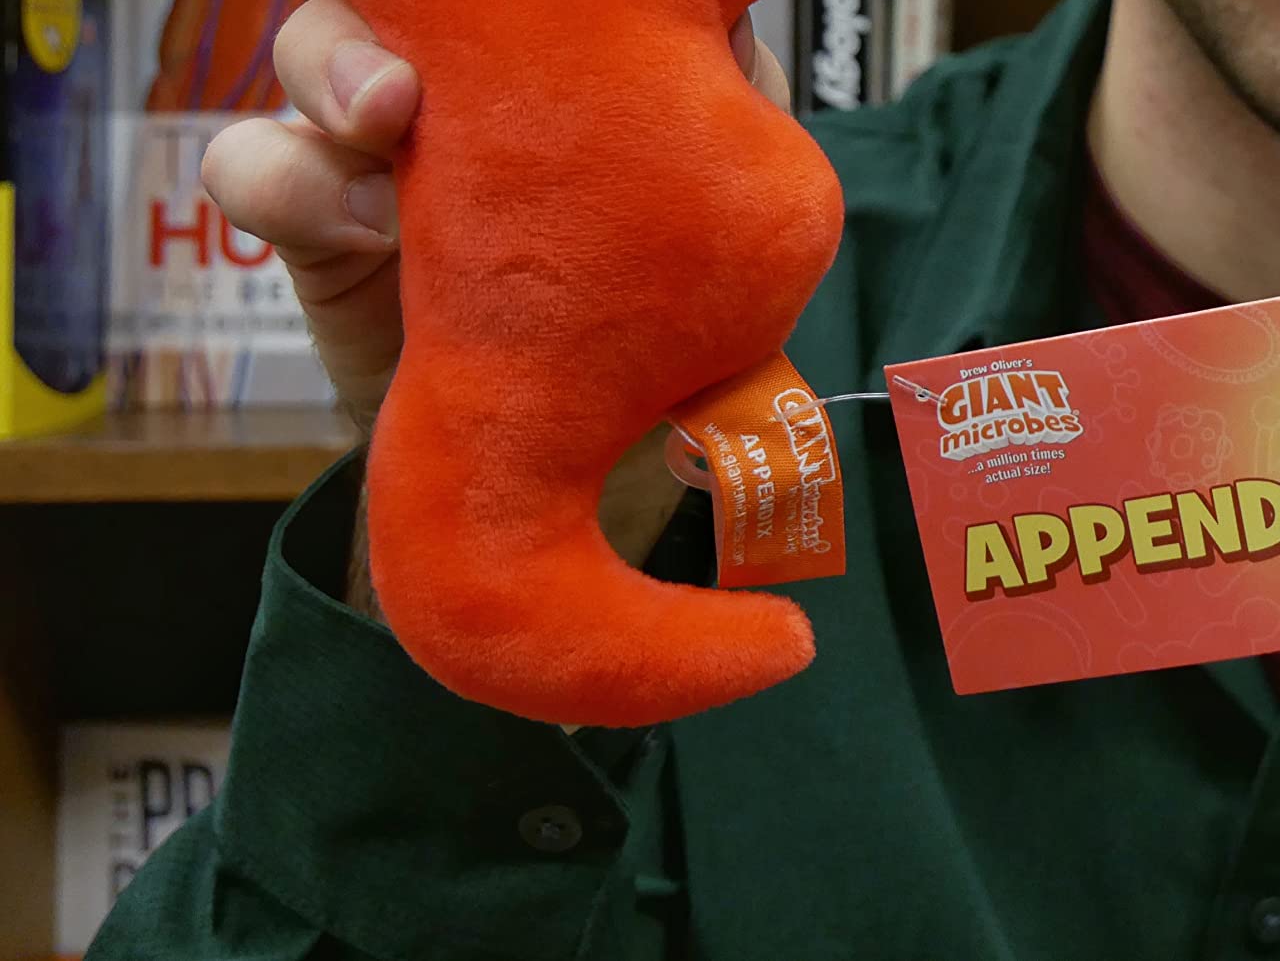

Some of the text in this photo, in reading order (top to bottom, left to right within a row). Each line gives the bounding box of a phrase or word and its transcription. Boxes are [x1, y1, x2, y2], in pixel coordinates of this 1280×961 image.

[148, 201, 273, 267] HU
[960, 358, 1033, 380] Drew Oliver's
[938, 371, 1069, 430] GIANT
[940, 412, 1083, 459] microbes
[986, 450, 1028, 469] million
[1031, 448, 1065, 463] times
[739, 433, 775, 539] APPENDIX
[985, 463, 1052, 484] actual size!
